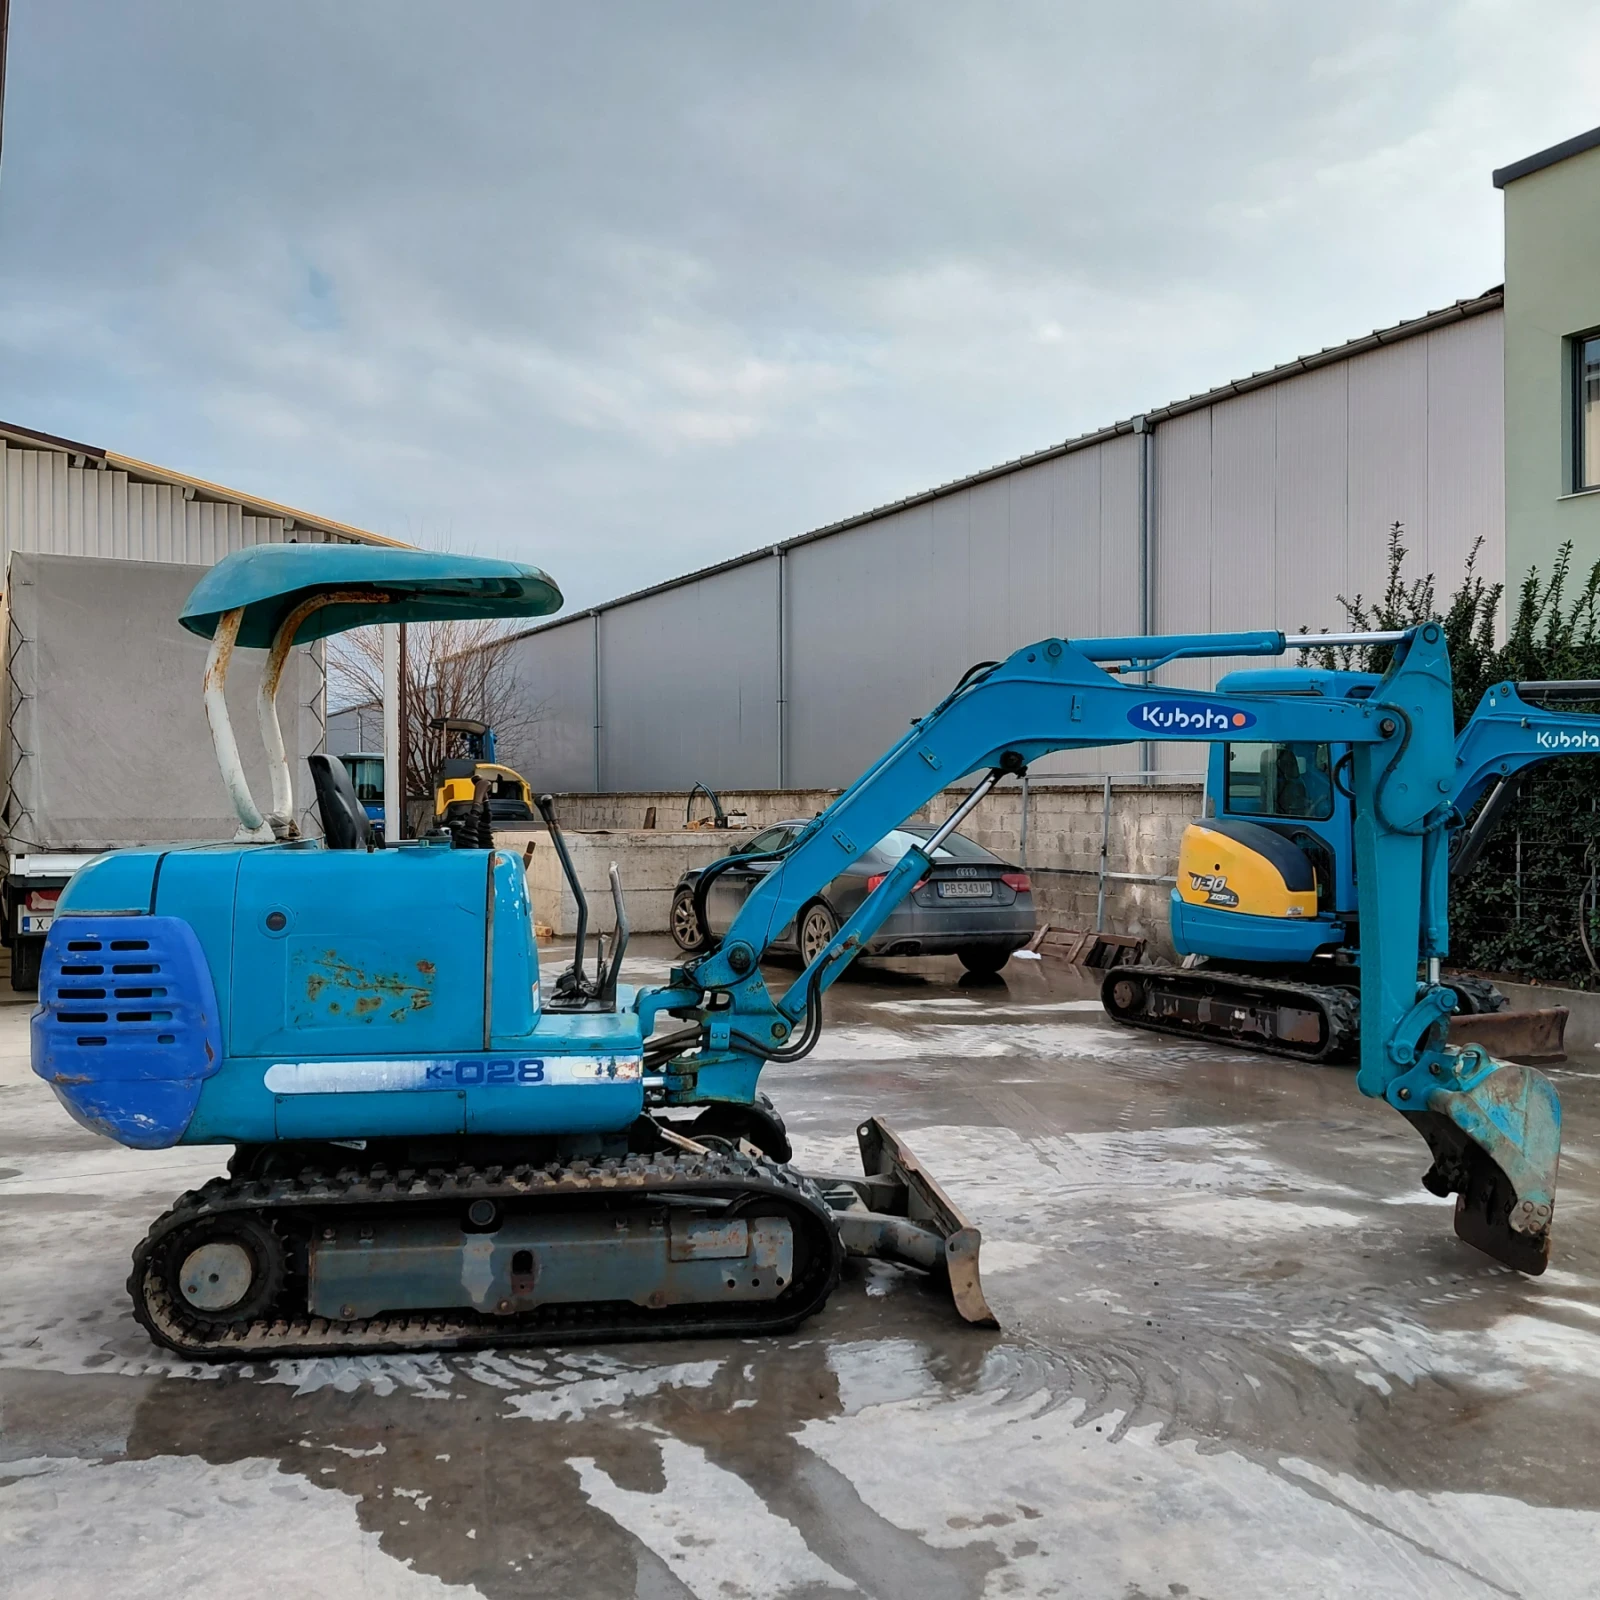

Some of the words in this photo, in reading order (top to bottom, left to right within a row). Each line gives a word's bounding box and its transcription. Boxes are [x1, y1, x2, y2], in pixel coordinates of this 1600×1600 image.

[1142, 706, 1228, 729] Kubota
[1536, 731, 1599, 748] Kubota
[1191, 875, 1227, 892] U-30
[426, 1059, 545, 1084] K-028
